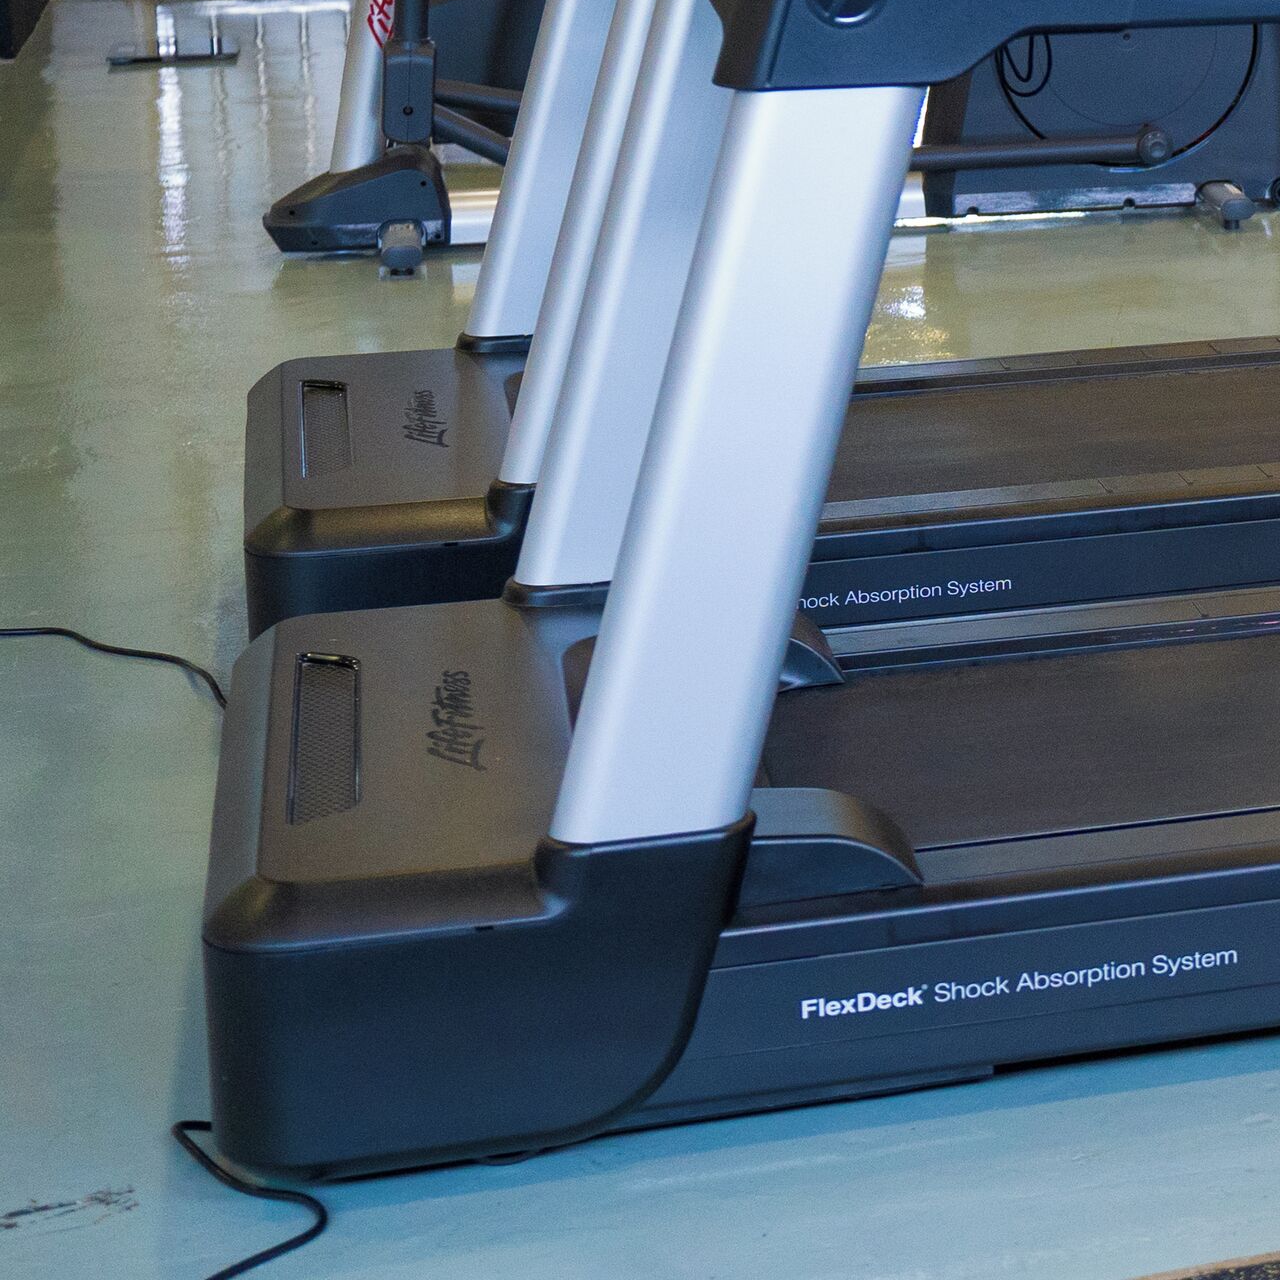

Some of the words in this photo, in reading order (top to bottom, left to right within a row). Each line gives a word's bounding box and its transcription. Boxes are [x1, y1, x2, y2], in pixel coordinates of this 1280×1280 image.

[796, 592, 840, 609] hock
[844, 584, 942, 606] Absorption
[947, 578, 1012, 598] System
[934, 976, 1010, 1003] Shock
[1015, 960, 1146, 993] Absorption
[1151, 949, 1238, 977] System
